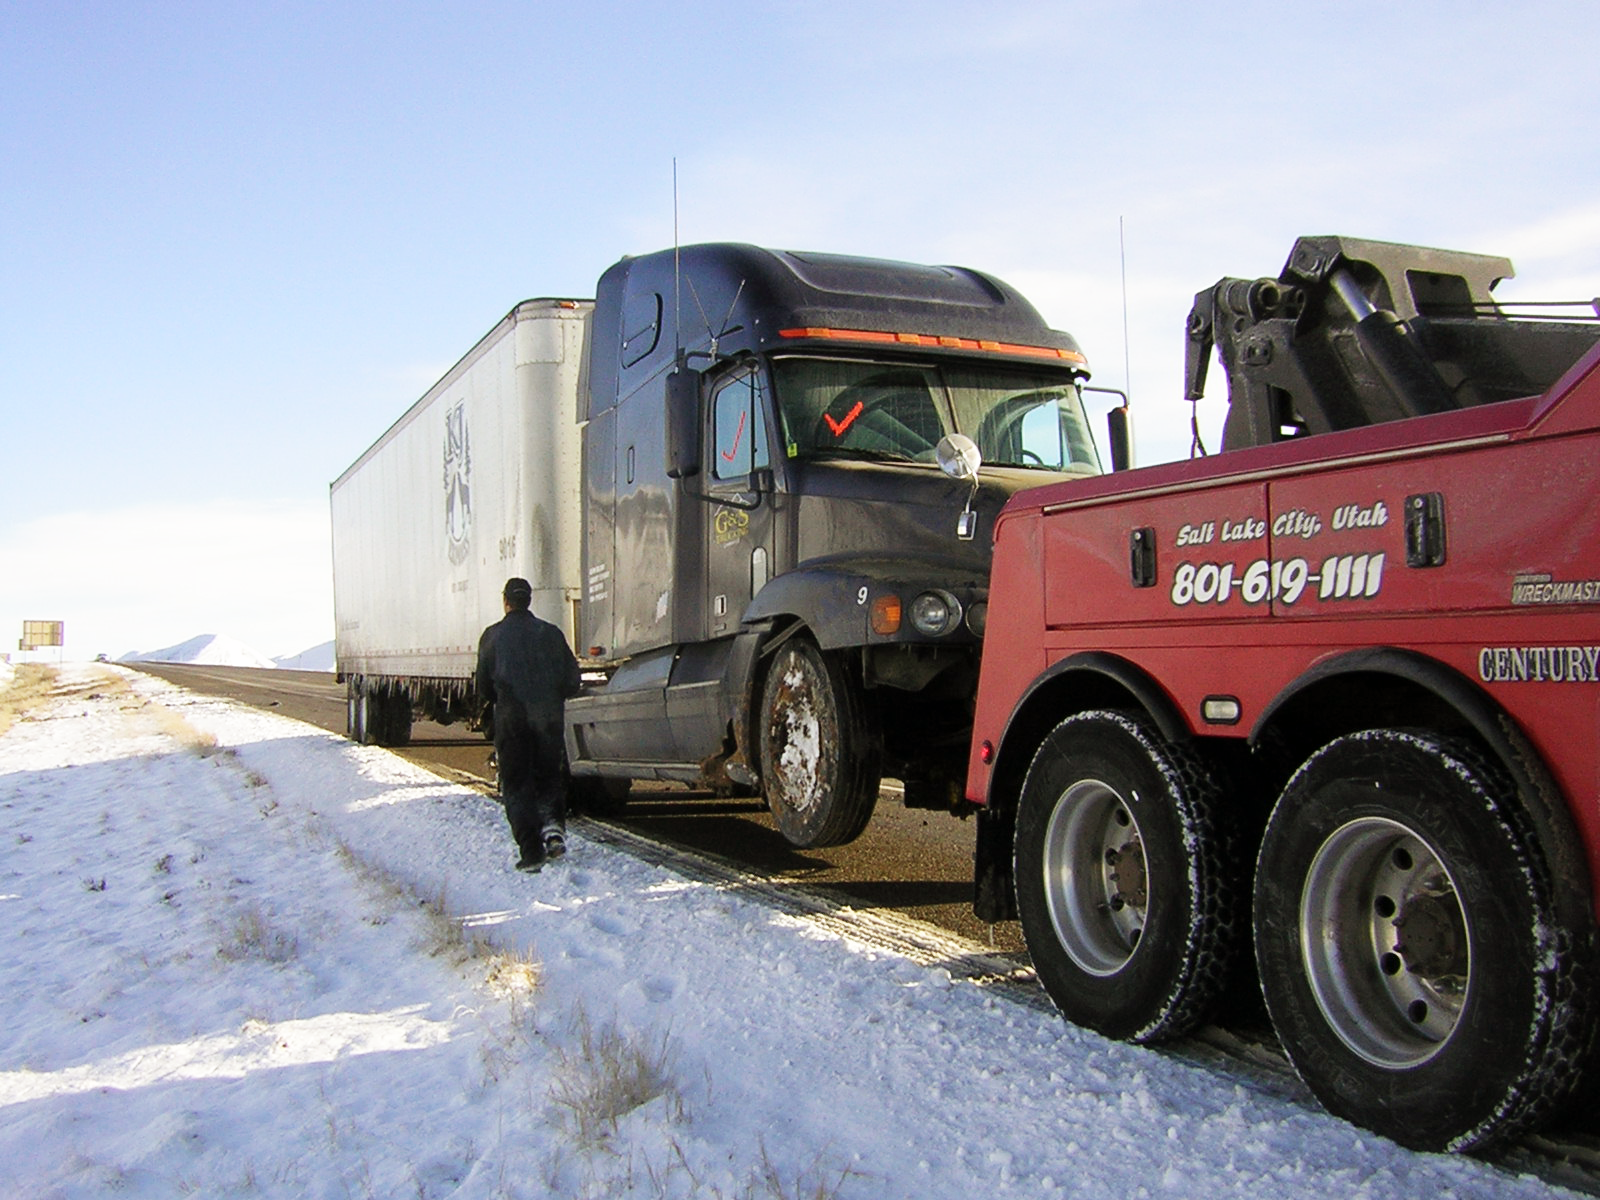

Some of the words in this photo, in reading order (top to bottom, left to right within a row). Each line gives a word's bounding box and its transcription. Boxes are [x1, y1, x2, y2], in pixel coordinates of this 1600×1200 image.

[1176, 521, 1215, 546] Salt
[1221, 517, 1265, 541] Lake
[1273, 509, 1322, 539] City,
[1331, 502, 1388, 530] Utah
[857, 586, 868, 605] 9
[1171, 553, 1385, 605] 801-619-1111
[1479, 647, 1600, 682] CENTURY
